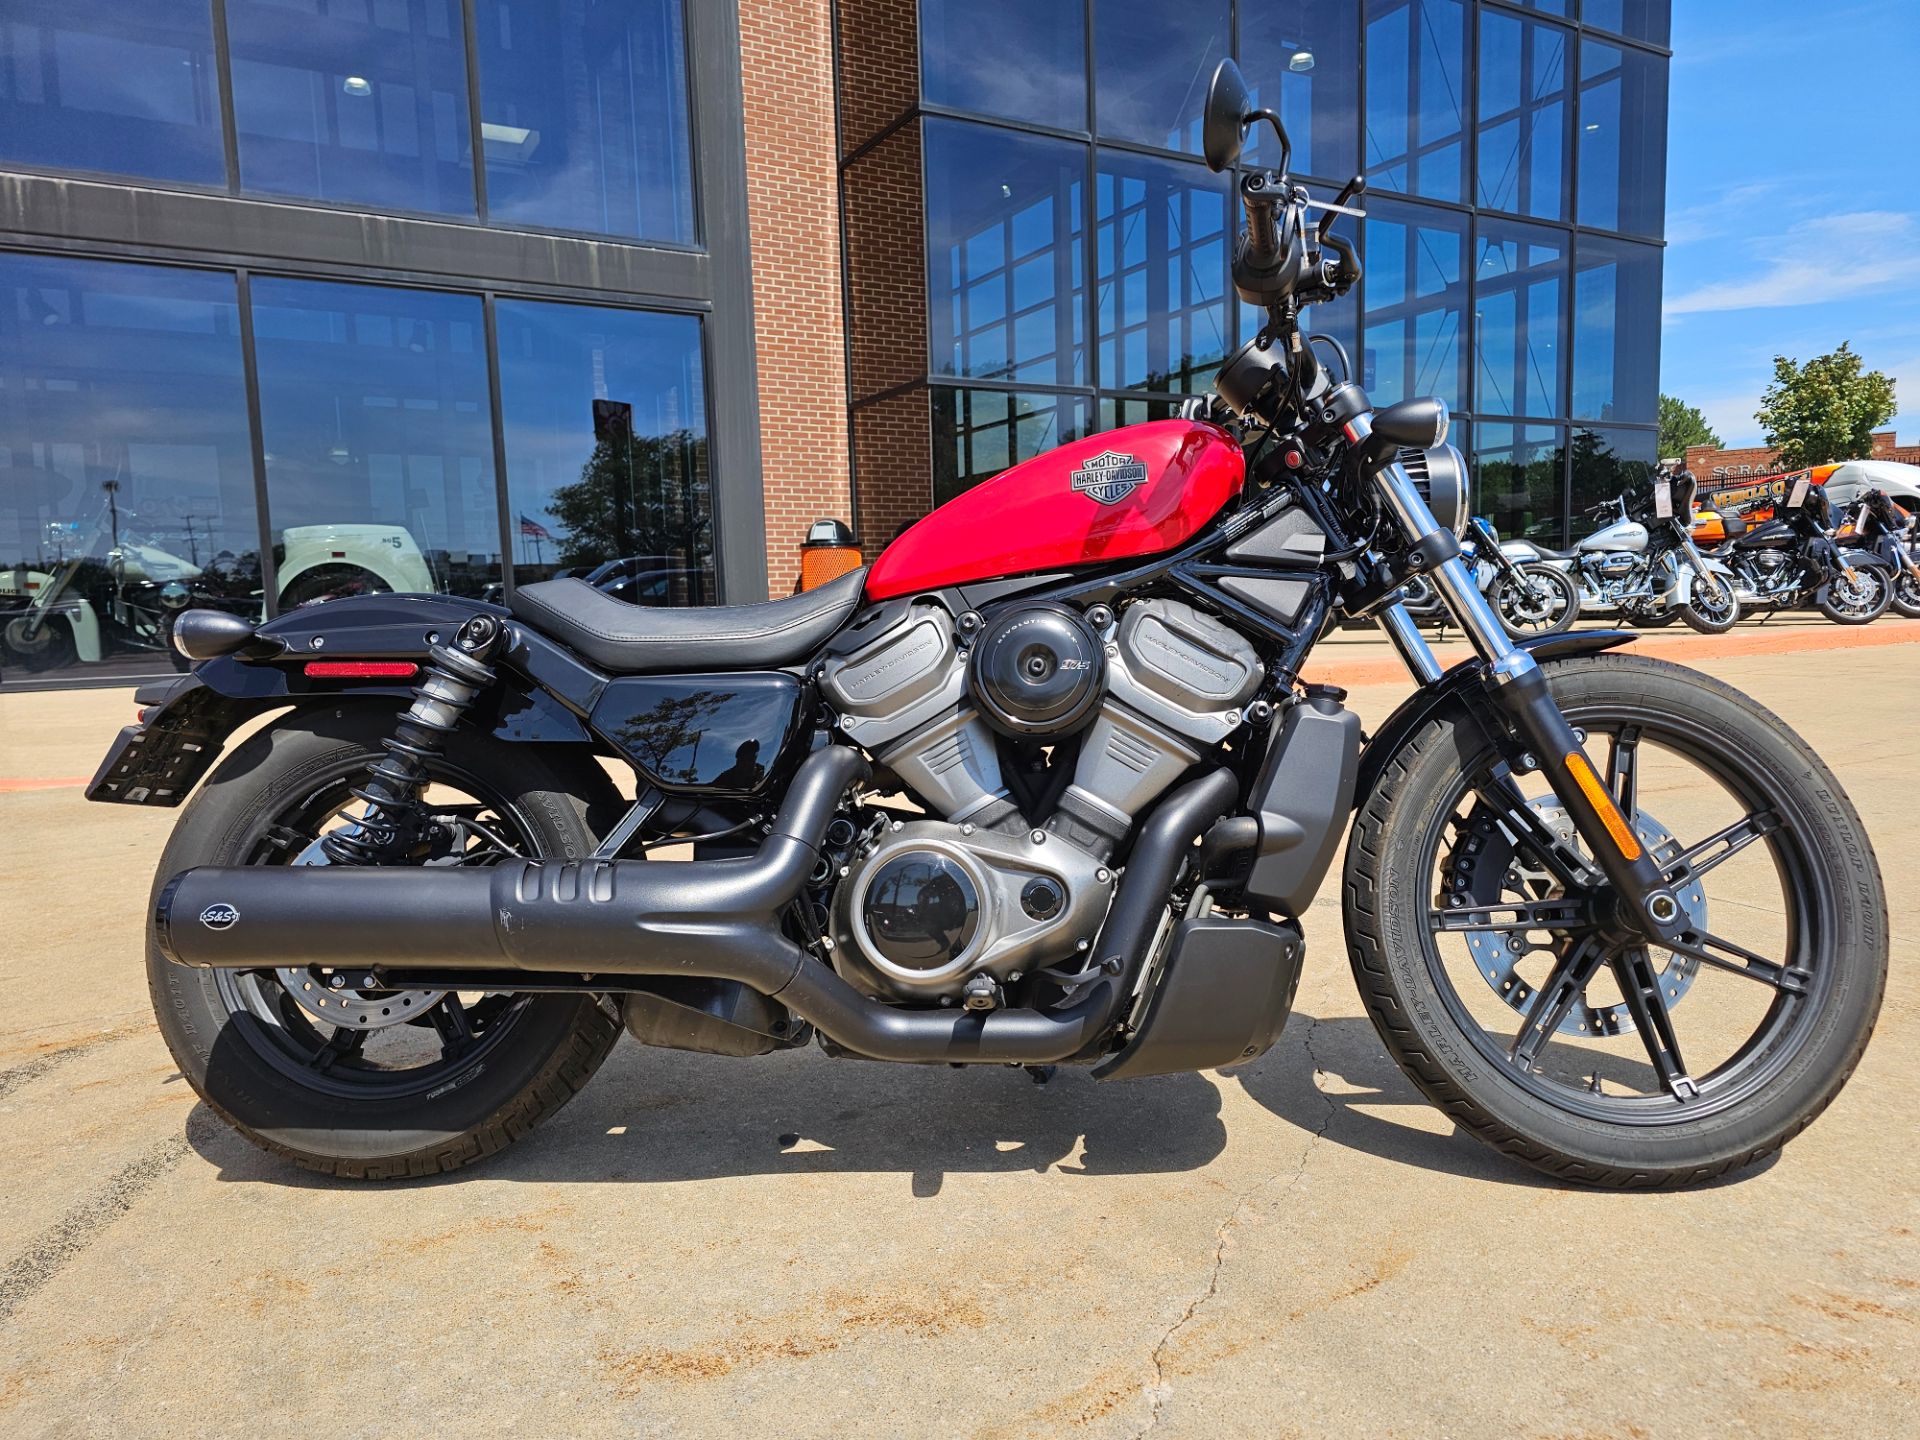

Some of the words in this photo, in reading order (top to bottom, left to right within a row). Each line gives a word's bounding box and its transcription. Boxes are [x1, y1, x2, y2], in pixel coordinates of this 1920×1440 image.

[1091, 455, 1126, 468] MOTOR
[1076, 467, 1143, 486] HARLEY-DAVIDSON
[1092, 484, 1128, 500] CYCLES
[392, 536, 401, 548] 5
[851, 639, 933, 689] HARLEY-DAVIDSON
[205, 911, 232, 922] S&S
[1388, 868, 1479, 1083] HARLEY-DAVIDSON
